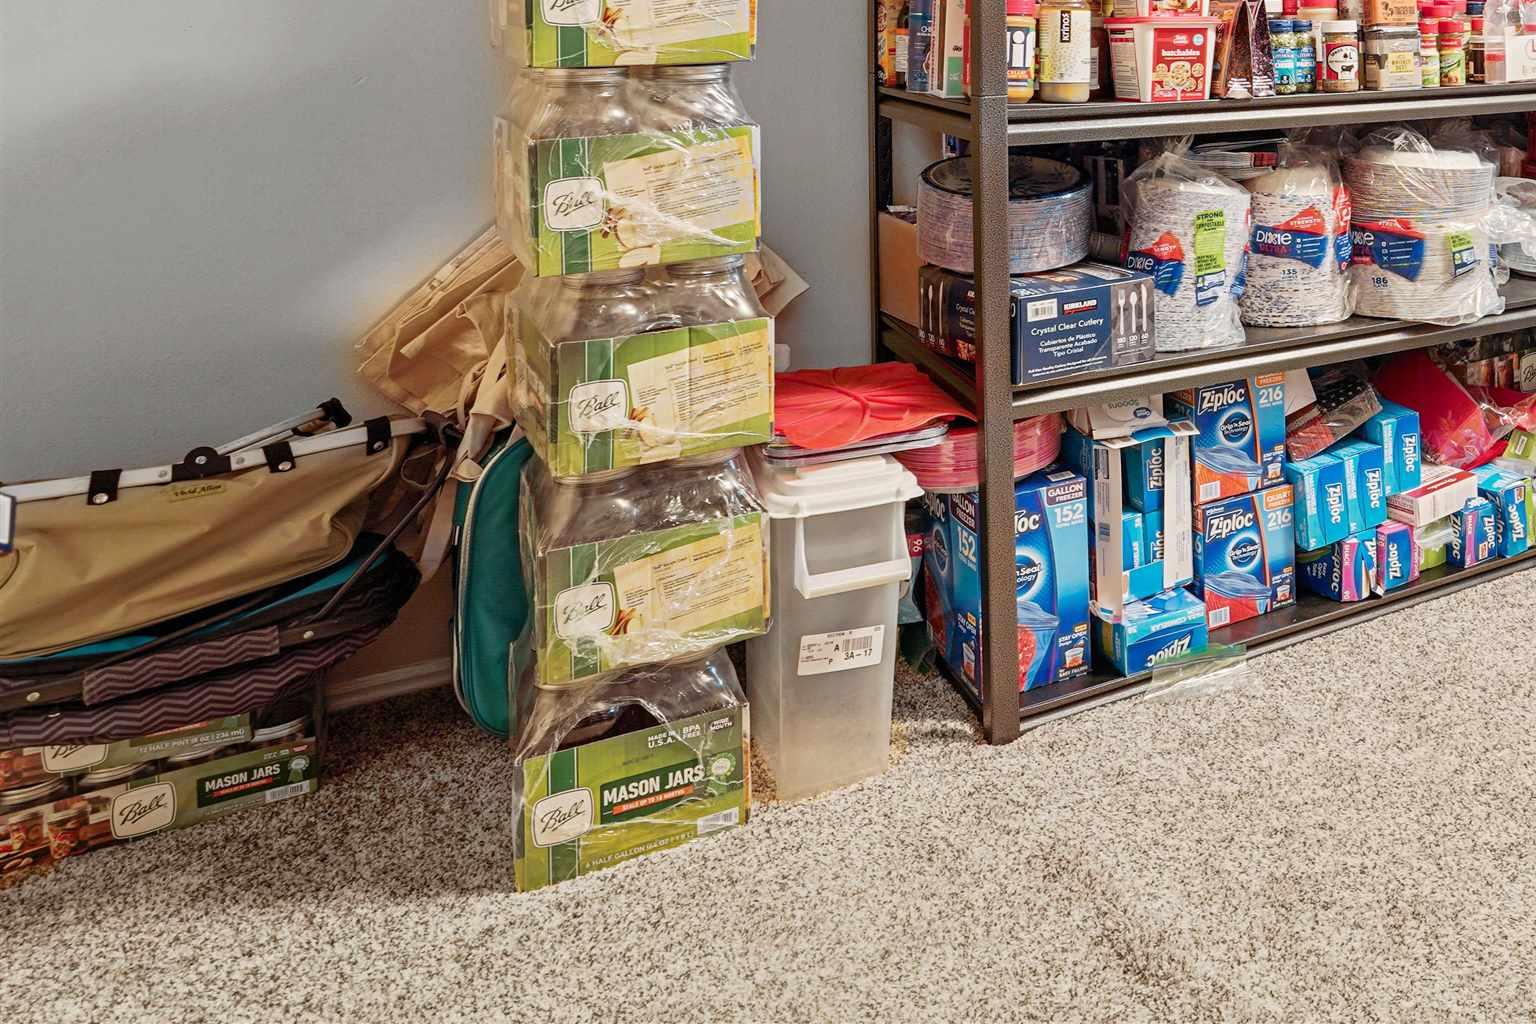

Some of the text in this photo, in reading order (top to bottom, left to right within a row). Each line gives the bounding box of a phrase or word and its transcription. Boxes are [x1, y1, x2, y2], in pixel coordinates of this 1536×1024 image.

[1061, 12, 1072, 43] krinos
[1197, 211, 1223, 220] STRONG
[1256, 231, 1291, 245] Dixie
[1064, 300, 1097, 311] KIRKLAND
[1031, 318, 1104, 337] Crystal Clear Cutlery
[1040, 337, 1066, 347] Cubiertos
[1053, 350, 1065, 358] Tipo
[577, 391, 620, 419] Ball
[1202, 388, 1244, 411] Ziploc
[1259, 387, 1283, 403] 216
[1404, 436, 1417, 473] Ziploc
[1150, 447, 1162, 489] Ziploc
[1048, 483, 1083, 497] GALLON
[1056, 492, 1083, 502] FREEZER
[1366, 470, 1380, 508] Ziploc
[1054, 505, 1083, 523] 152
[1327, 486, 1343, 524] Ziploc
[956, 507, 976, 528] FREEZER
[1210, 513, 1254, 538] Ziploc
[1268, 510, 1291, 528] 216
[1508, 505, 1524, 541] Ziploc
[1451, 514, 1461, 560] Ziploc
[1484, 515, 1496, 549] Ziploc
[958, 528, 977, 561] 152
[1020, 564, 1041, 576] Seal
[1389, 543, 1401, 580] Ziploc
[563, 593, 607, 626] Ball
[834, 644, 840, 652] A
[1058, 635, 1072, 644] STAY
[1145, 634, 1192, 667] Ziploc
[648, 732, 667, 743] MADE
[682, 723, 700, 735] BPA
[710, 722, 733, 732] MOUTH
[648, 737, 676, 749] U.S.A.
[205, 763, 281, 793] MASON JARS
[603, 765, 705, 807] MASON JARS
[119, 792, 168, 825] Ball
[541, 799, 586, 834] Ball
[592, 844, 644, 866] HALF GALLON
